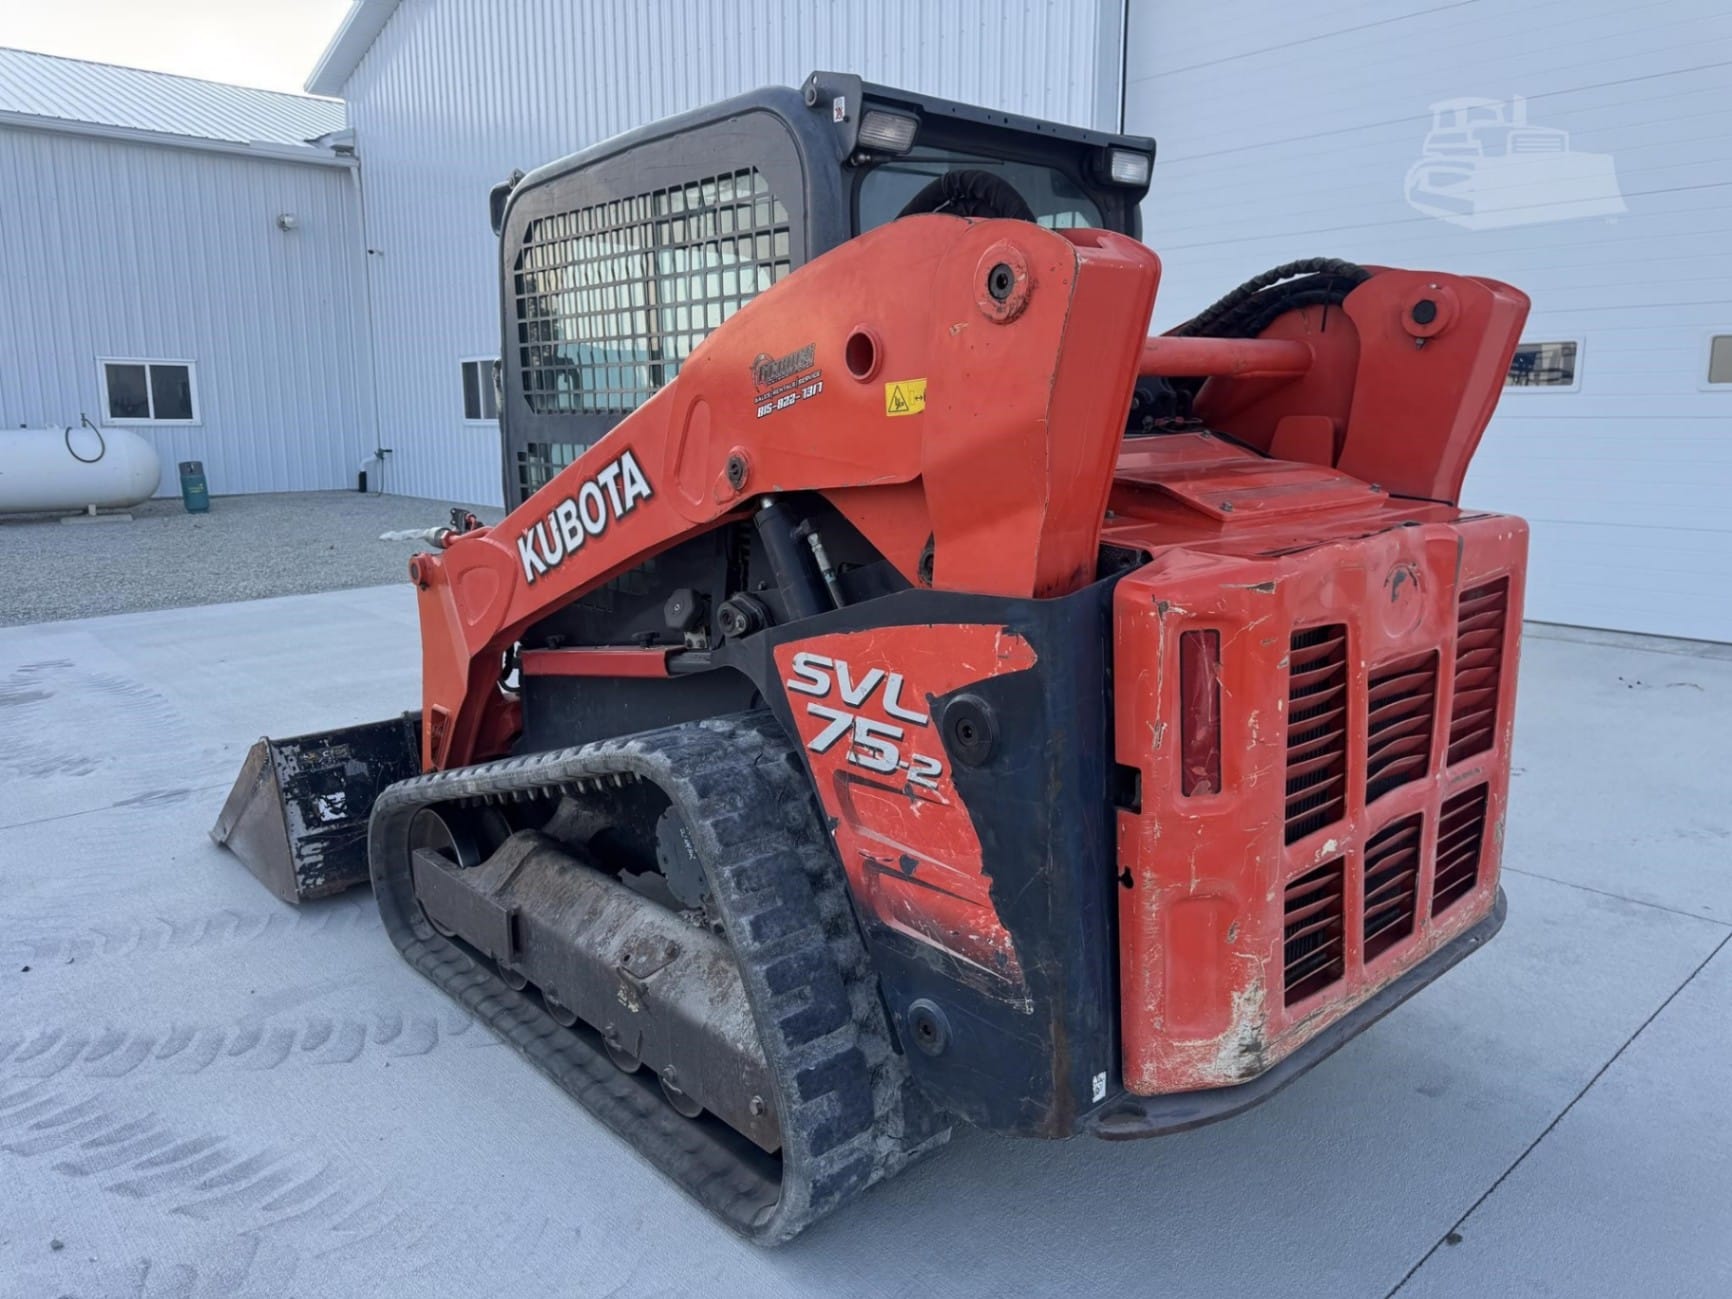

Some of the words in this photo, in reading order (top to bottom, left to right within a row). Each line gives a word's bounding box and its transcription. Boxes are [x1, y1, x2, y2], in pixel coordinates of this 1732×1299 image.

[516, 450, 652, 583] KUBOTA
[787, 652, 929, 725] SVL
[806, 702, 943, 790] 75-2
